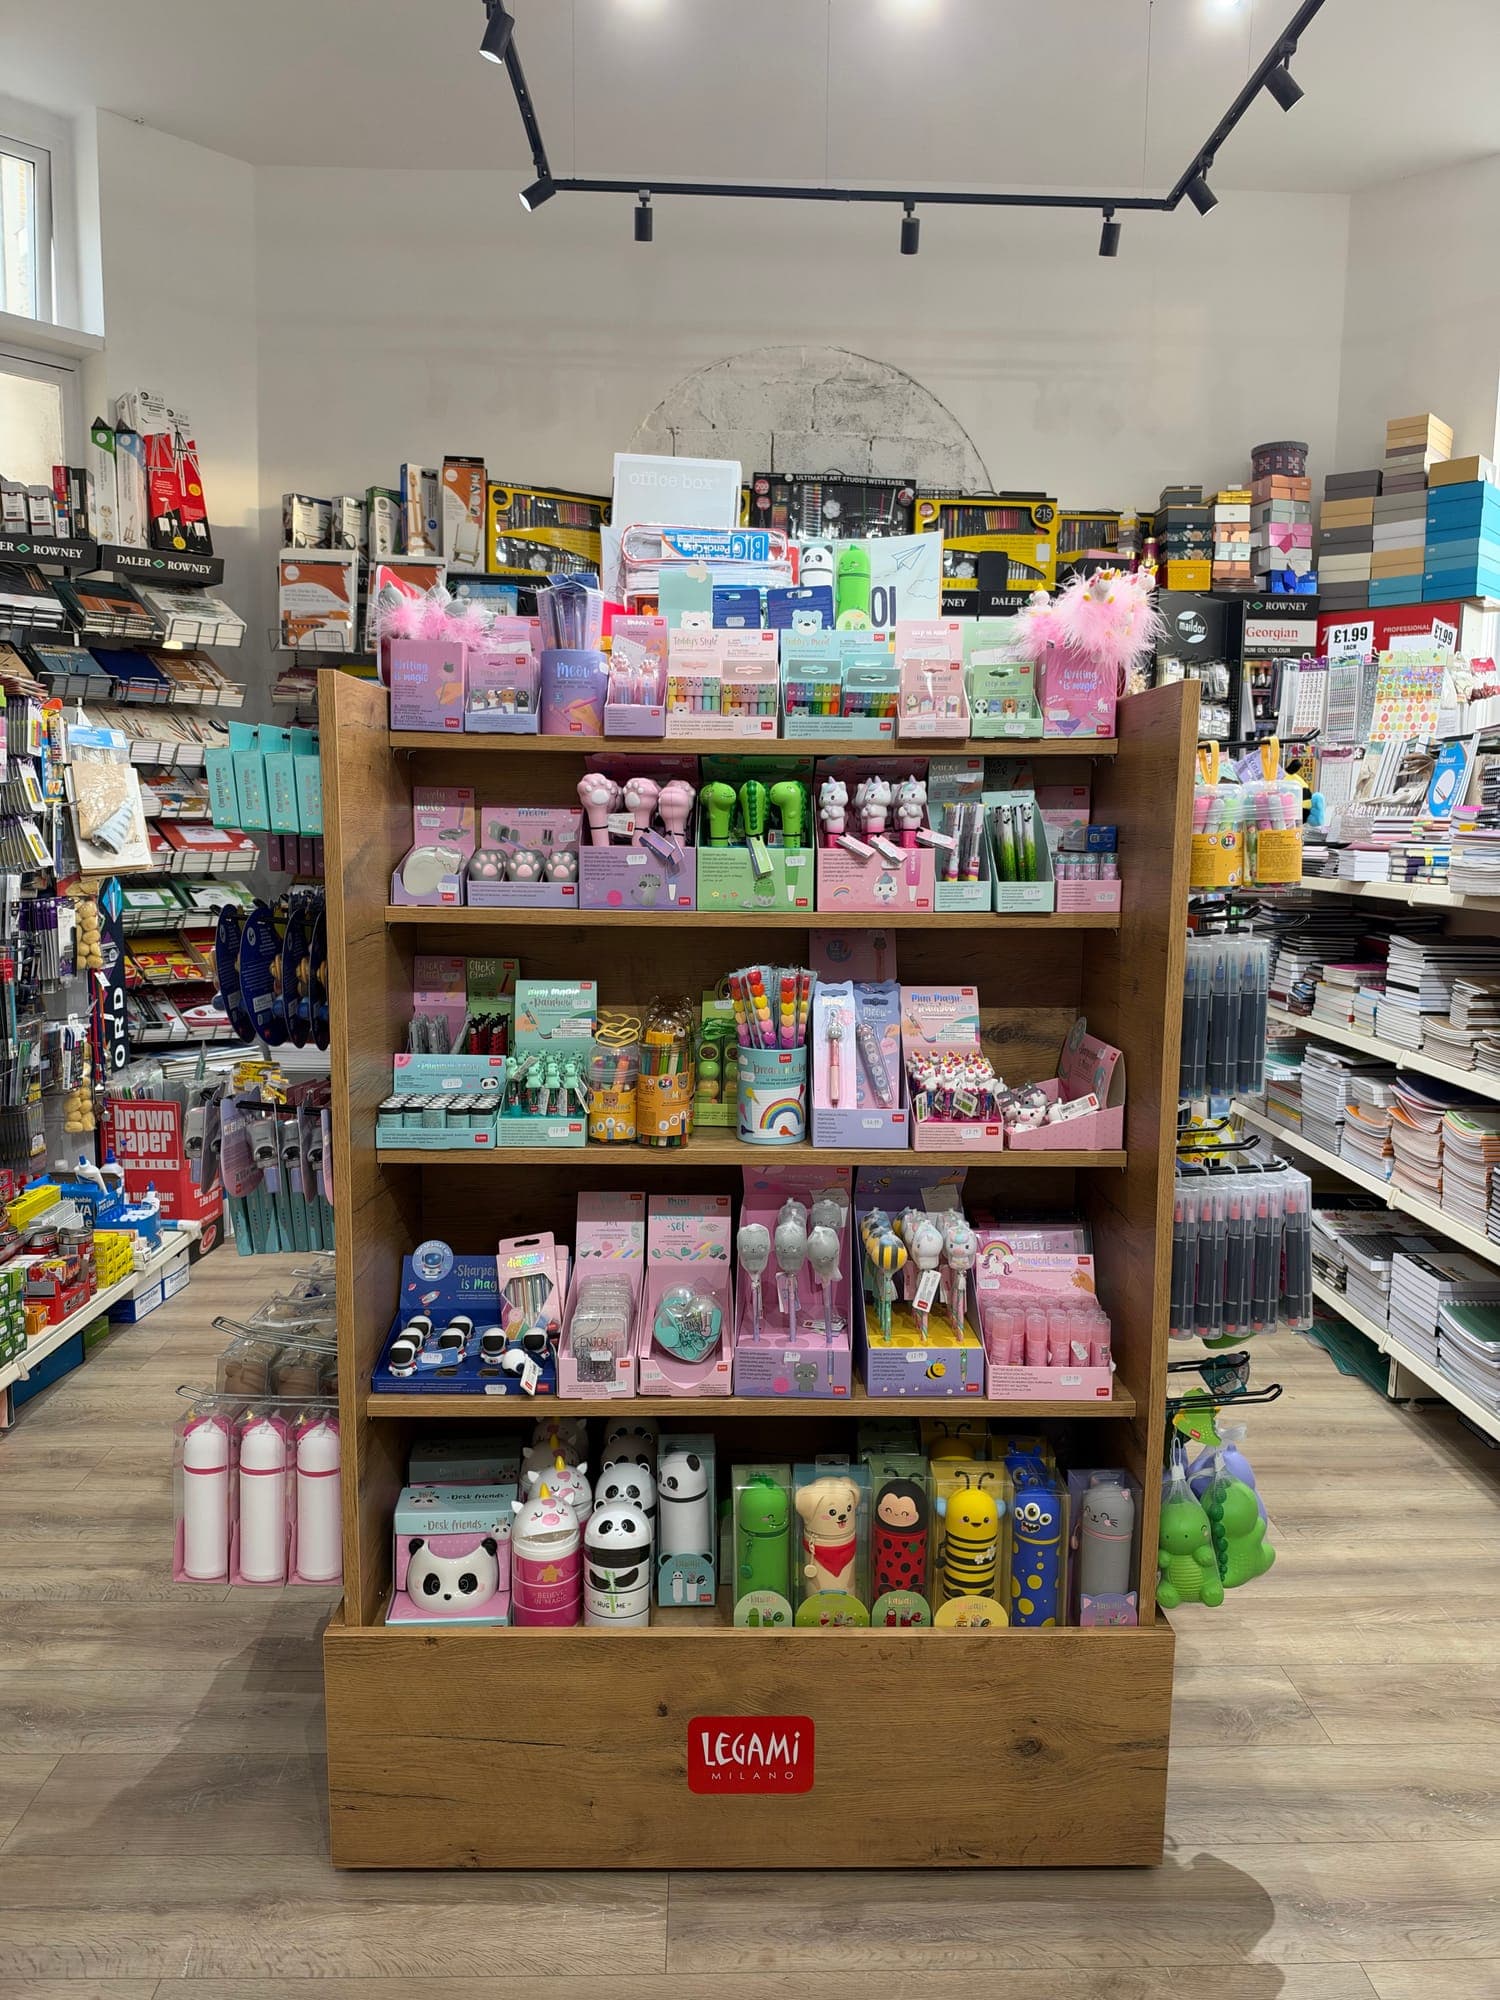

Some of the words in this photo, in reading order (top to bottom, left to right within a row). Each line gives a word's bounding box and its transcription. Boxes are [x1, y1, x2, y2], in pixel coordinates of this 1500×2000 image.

[682, 473, 713, 490] box
[1036, 508, 1053, 520] 215
[33, 544, 83, 559] ROWNEY
[116, 554, 152, 568] DALER
[167, 560, 212, 575] ROWNEY
[991, 597, 1023, 606] DALER
[1265, 602, 1308, 611] ROWNEY
[1178, 620, 1206, 635] maildor
[1383, 624, 1431, 633] PROFESSIONAL
[1246, 627, 1298, 642] Georgian
[1334, 626, 1368, 643] £1.99
[1434, 624, 1453, 646] £1.99
[114, 1105, 175, 1131] brown
[115, 1131, 171, 1157] paper
[75, 1205, 92, 1216] VA
[461, 1278, 469, 1289] is
[475, 1492, 505, 1500] friends
[428, 1519, 448, 1530] Desk
[452, 1518, 482, 1531] friends
[597, 1600, 610, 1608] HUG
[711, 1771, 794, 1780] MILANO
